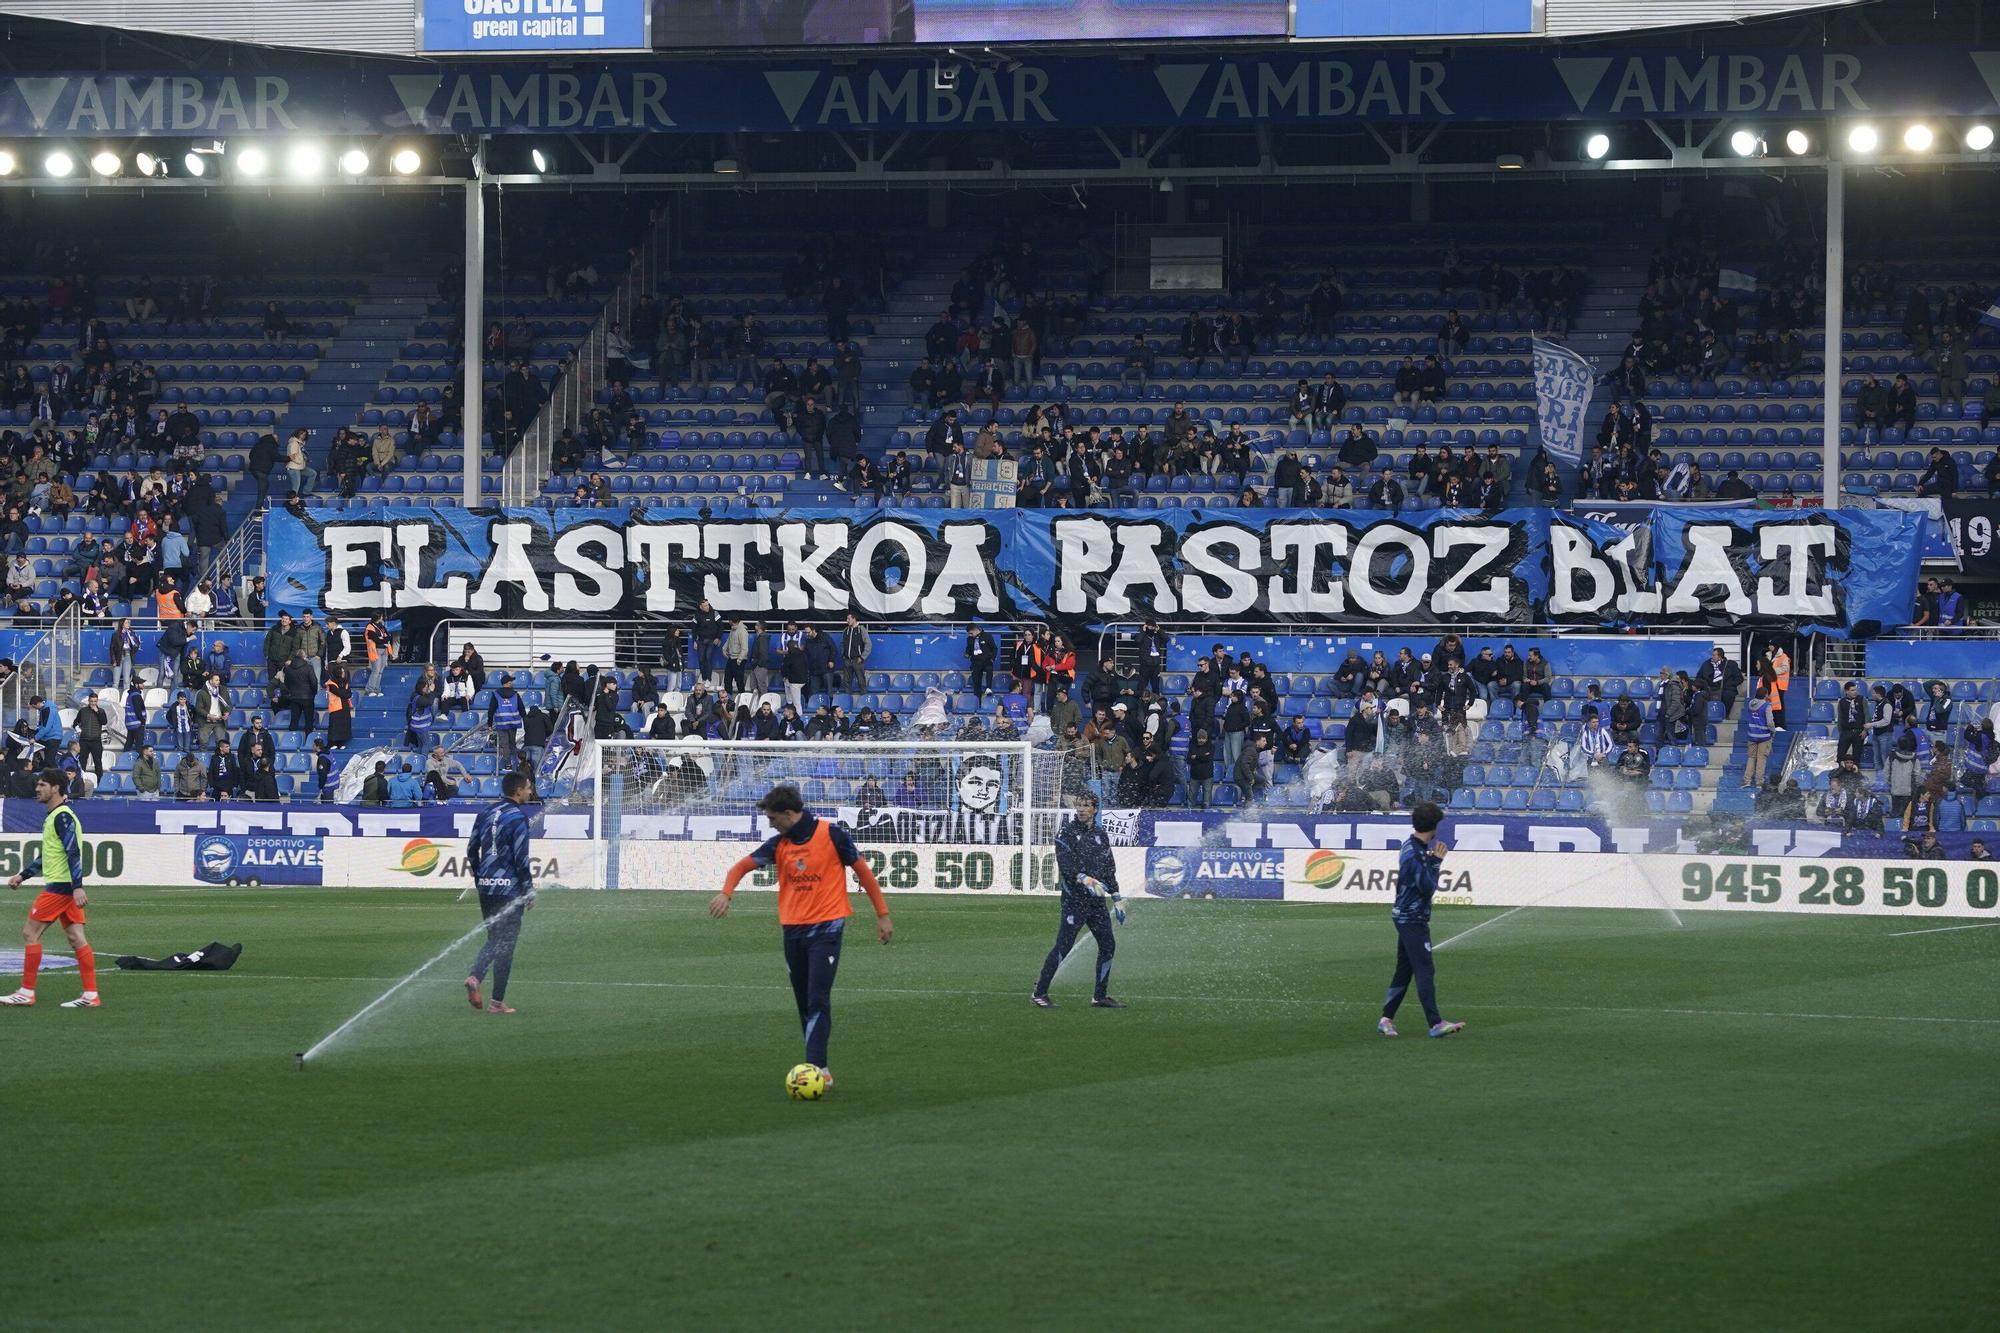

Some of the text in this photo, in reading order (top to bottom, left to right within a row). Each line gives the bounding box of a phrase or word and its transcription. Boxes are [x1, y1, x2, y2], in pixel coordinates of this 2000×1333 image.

[473, 16, 577, 39] green capital
[66, 75, 300, 131] AMBAR
[440, 71, 678, 128] AMBAR
[816, 66, 1059, 125] AMBAR
[1205, 60, 1456, 118] AMBAR
[1609, 53, 1871, 114] AMBAR
[1949, 515, 2000, 556] 19
[322, 519, 1837, 616] ELASTIKOA PASIOZ BLAI
[247, 838, 305, 848] DEPORTIVO
[1102, 819, 1129, 828] SKAL
[935, 851, 994, 890] 50
[1196, 858, 1284, 880] ALAVÉS
[1202, 851, 1261, 861] DEPORTIVO
[1682, 862, 1782, 904] 945
[1798, 865, 1865, 906] 28
[1882, 867, 1949, 908] 50
